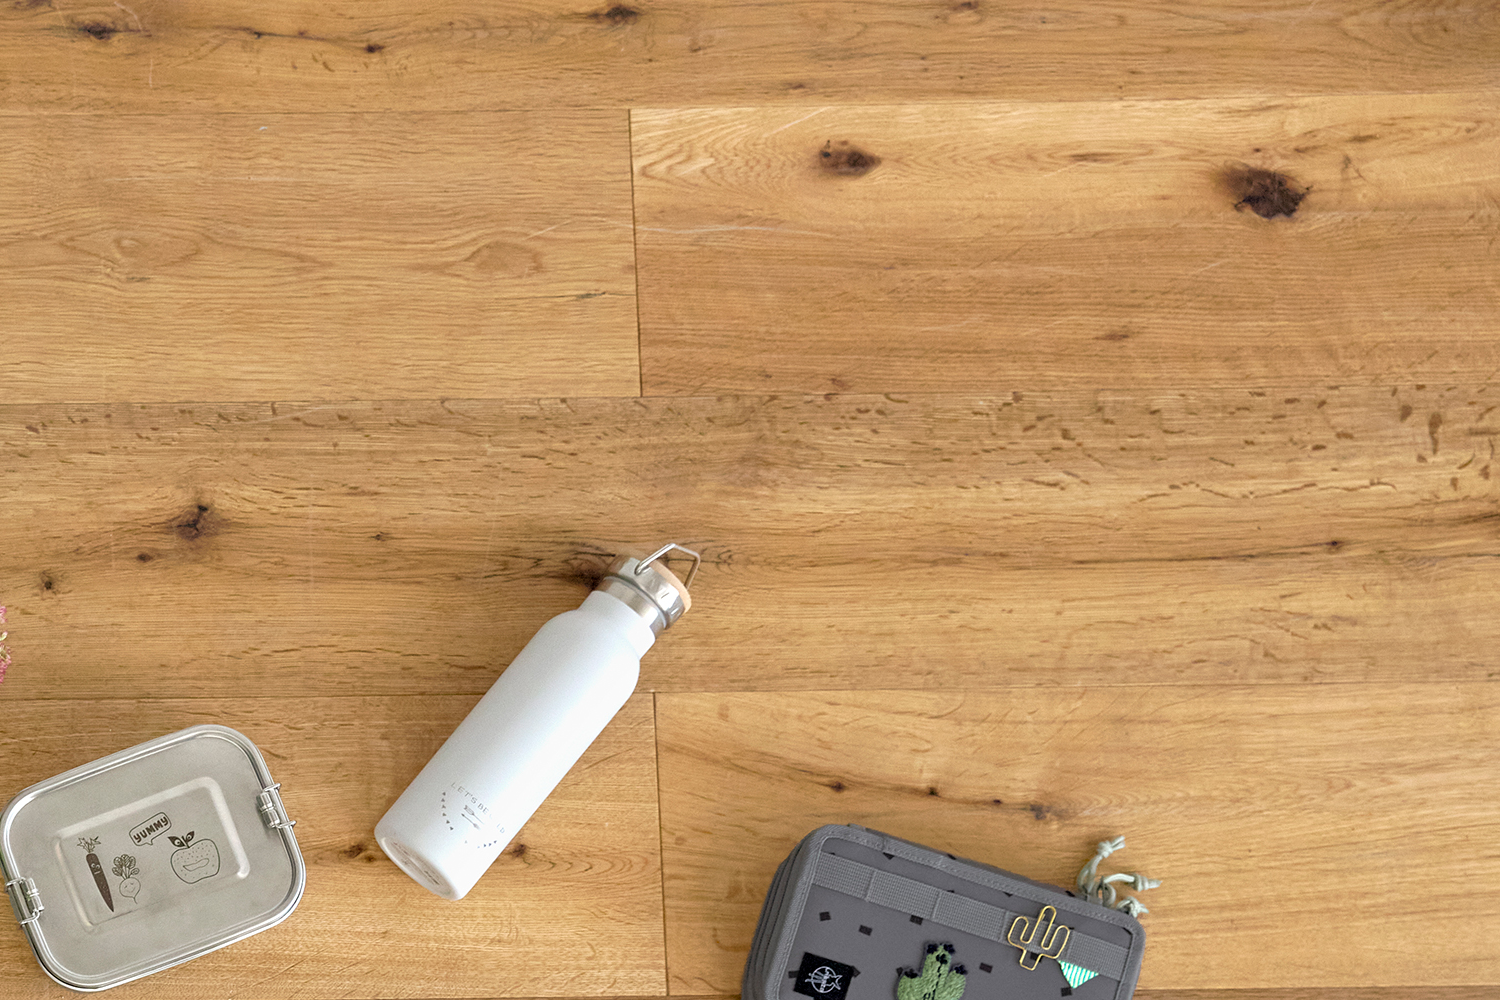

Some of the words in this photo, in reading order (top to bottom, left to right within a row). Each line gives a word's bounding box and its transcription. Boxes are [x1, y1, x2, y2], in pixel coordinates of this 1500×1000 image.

[451, 782, 478, 804] LET'S
[477, 803, 489, 815] BE
[133, 816, 169, 843] YUMMY
